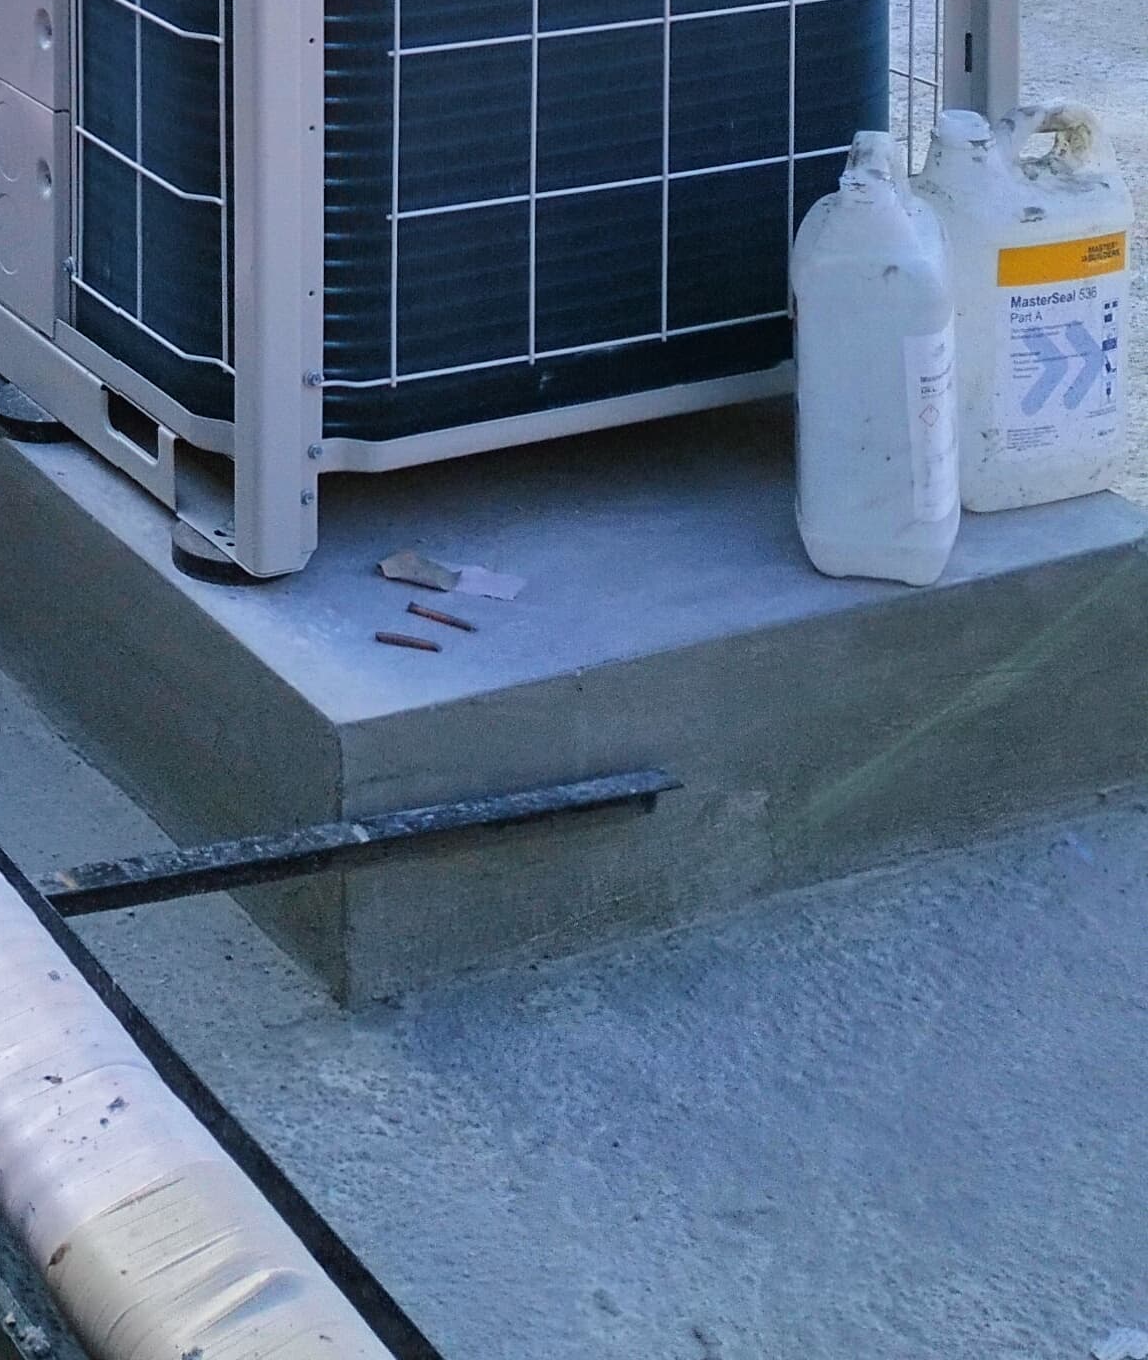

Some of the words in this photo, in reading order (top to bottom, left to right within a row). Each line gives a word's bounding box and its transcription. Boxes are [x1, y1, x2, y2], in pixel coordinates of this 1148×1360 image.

[1010, 289, 1076, 308] MasterSeal
[1010, 312, 1032, 324] Part
[1035, 311, 1043, 321] A
